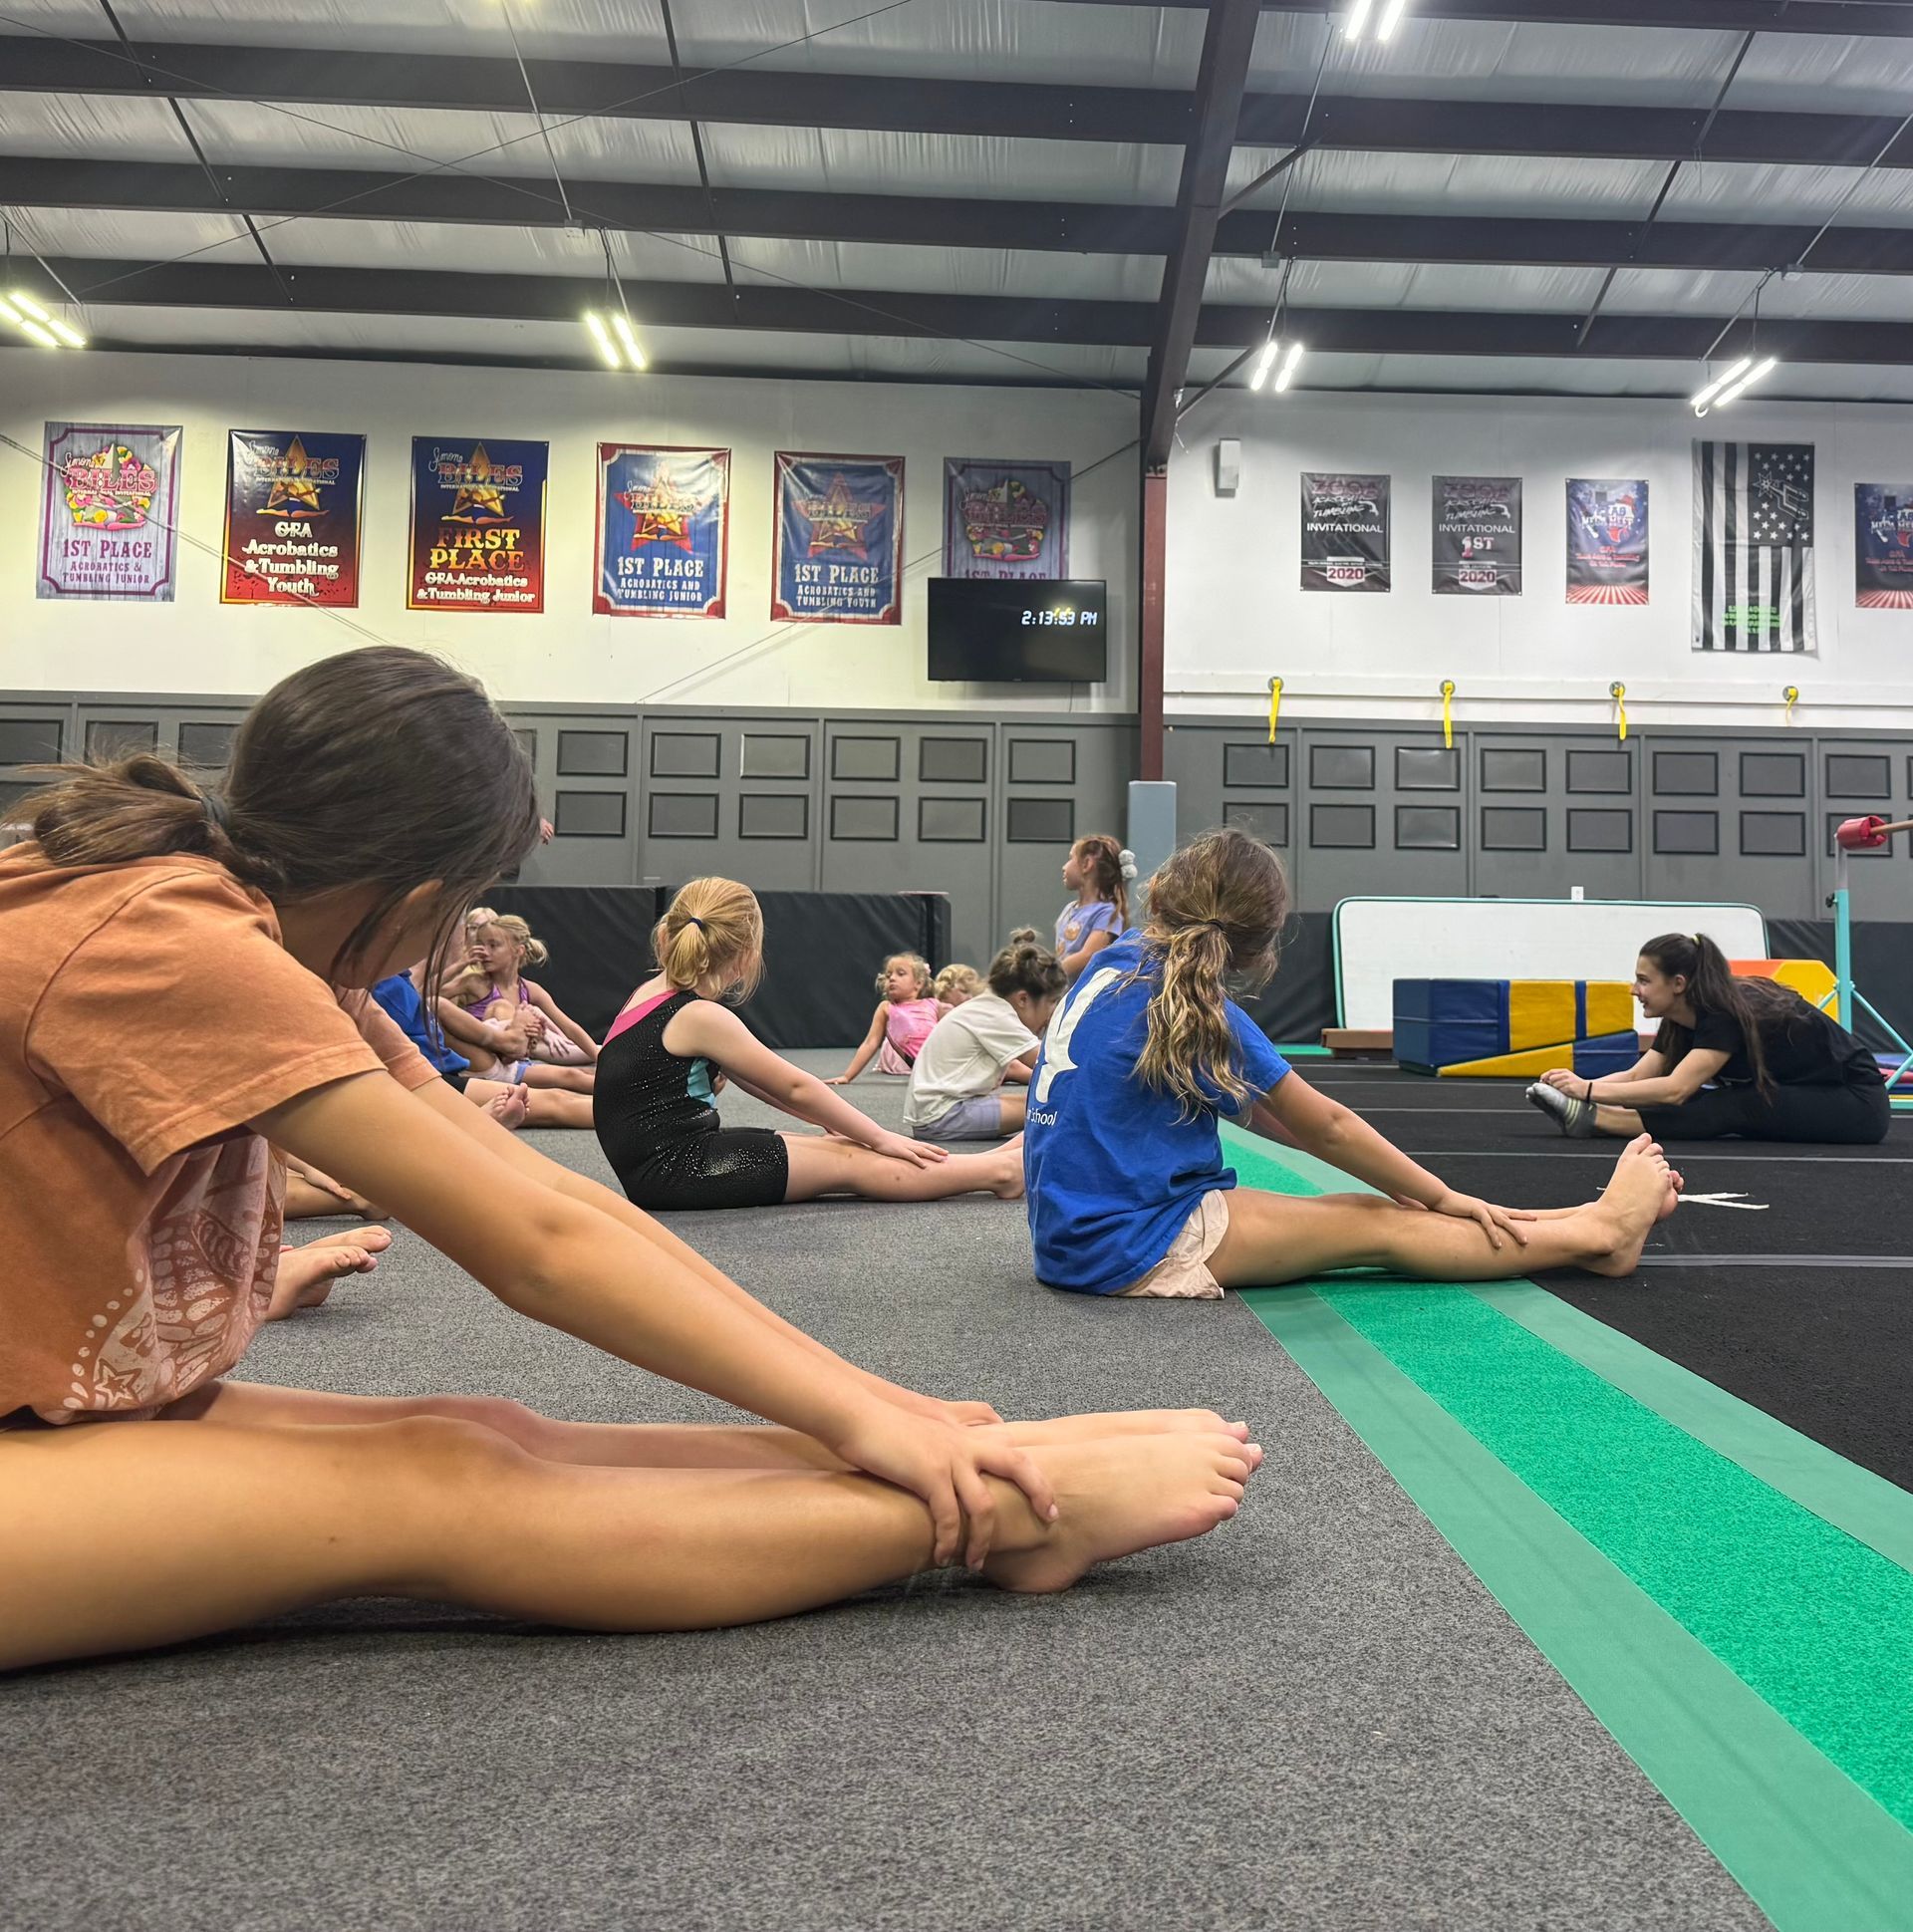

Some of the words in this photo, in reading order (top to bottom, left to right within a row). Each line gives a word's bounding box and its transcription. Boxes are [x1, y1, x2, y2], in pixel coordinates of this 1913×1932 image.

[70, 467, 157, 492] BILES
[438, 463, 522, 486] BILES
[274, 521, 313, 538] GRA
[1306, 522, 1383, 533] INVITATIONAL
[1439, 523, 1515, 534] INVITATIONAL
[436, 527, 520, 549] FIRST
[64, 539, 91, 557] 1ST
[101, 540, 151, 558] PLACE
[242, 539, 339, 557] Acrobatics
[1462, 536, 1495, 558] 1ST
[71, 561, 129, 571] ACROBATICS
[134, 562, 141, 572] &
[429, 549, 524, 571] PLACE
[618, 557, 645, 576] 1ST
[653, 558, 703, 577] PLACE
[63, 573, 111, 583] TUMBLING
[116, 573, 149, 583] JUNIOR
[795, 564, 822, 583] 1ST
[829, 564, 879, 584] PLACE
[1328, 567, 1364, 580] 2020
[1459, 571, 1496, 583] 2020
[267, 576, 320, 596] Youth
[621, 578, 678, 590] ACROBATICS
[682, 580, 699, 591] AND
[798, 585, 854, 596] ACROBATICS
[857, 587, 876, 596] AND
[492, 590, 535, 603] Junior
[617, 589, 665, 600] TUMBLING
[669, 591, 702, 602] JUNIOR
[796, 596, 843, 607] TUMBLING
[847, 598, 877, 608] YOUTH
[1021, 610, 1075, 626] 2:13:53
[1080, 611, 1098, 626] PM
